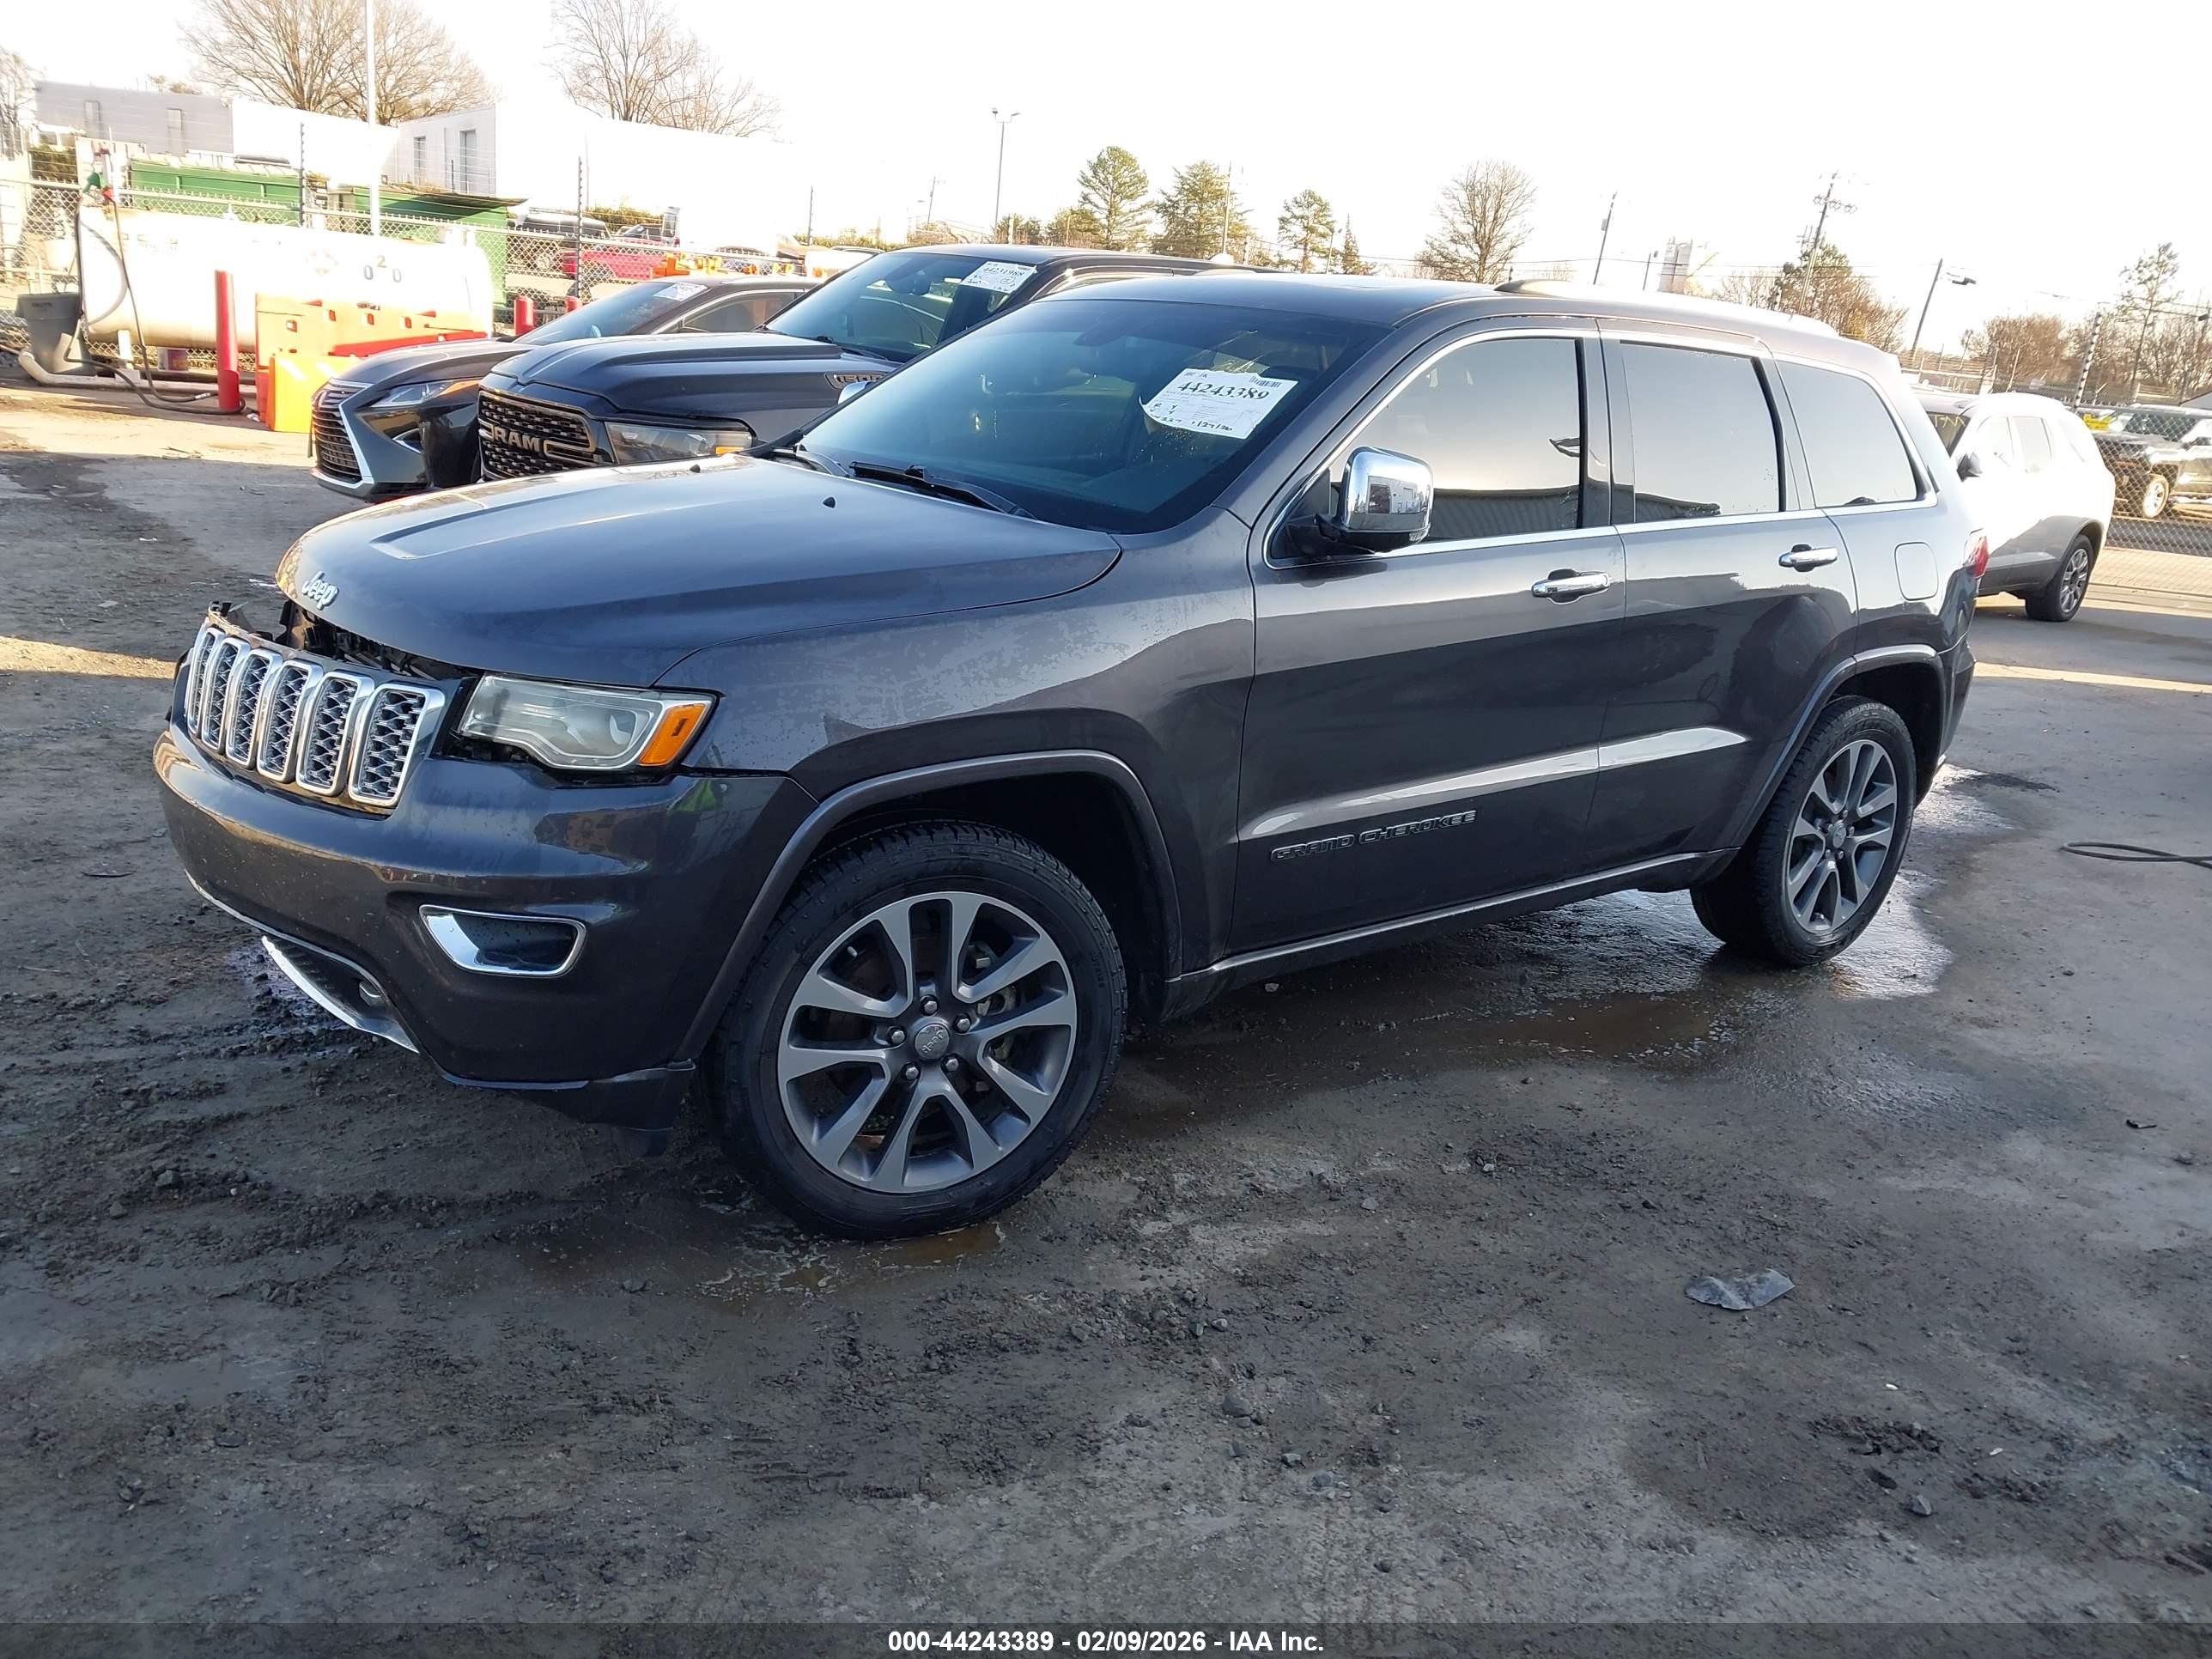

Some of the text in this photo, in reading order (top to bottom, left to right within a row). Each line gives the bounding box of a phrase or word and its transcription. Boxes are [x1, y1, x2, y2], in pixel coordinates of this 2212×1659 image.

[1177, 380, 1270, 400] 44243389
[494, 426, 540, 453] RAM
[301, 571, 340, 611] Jeep
[1271, 810, 1477, 861] GRAND CHEROKEE
